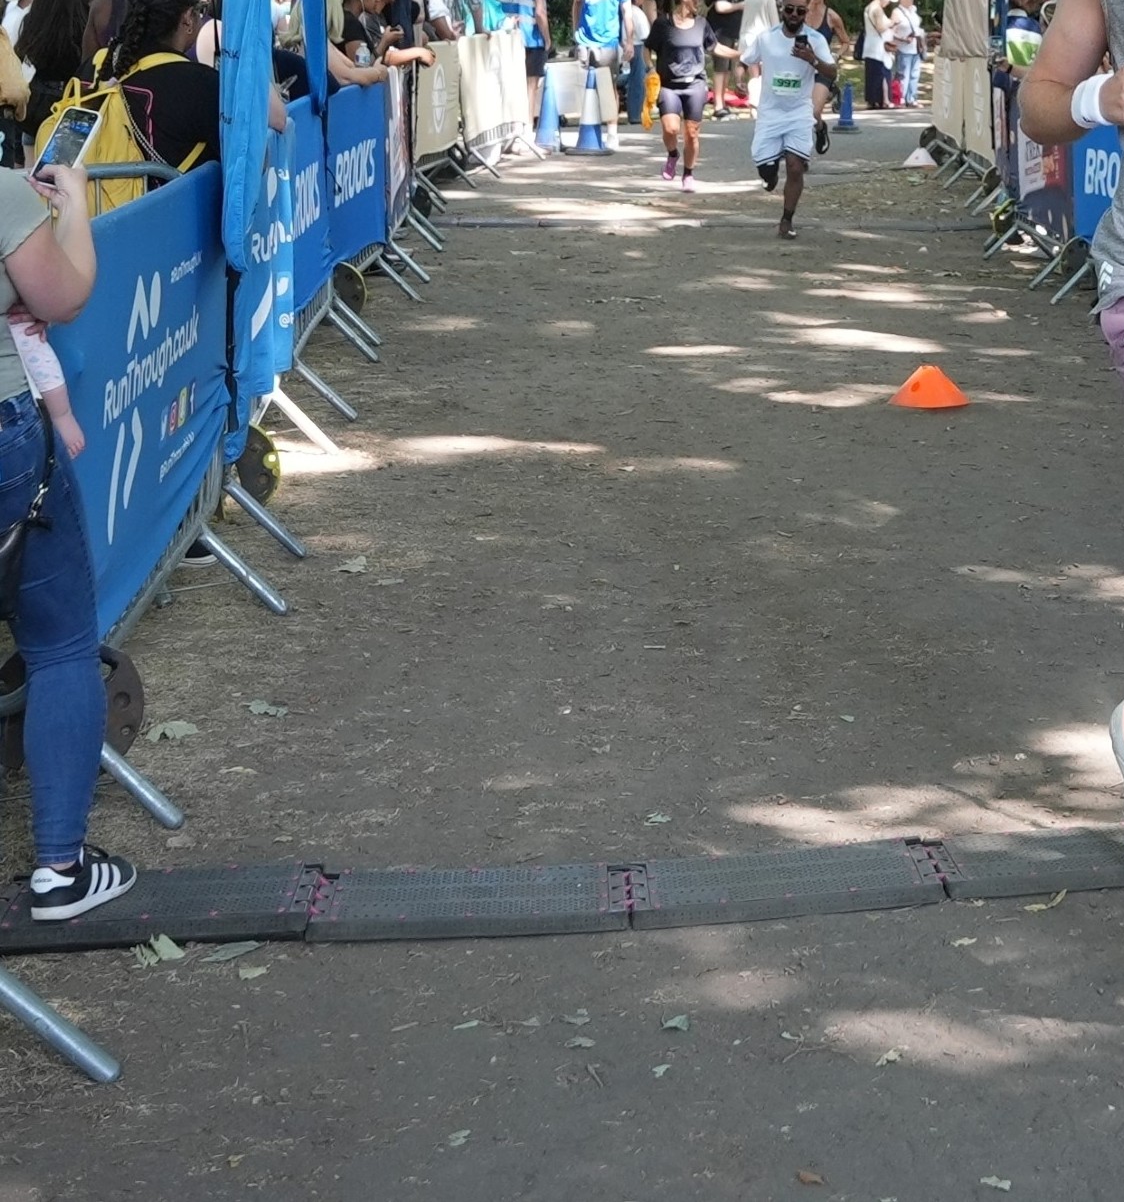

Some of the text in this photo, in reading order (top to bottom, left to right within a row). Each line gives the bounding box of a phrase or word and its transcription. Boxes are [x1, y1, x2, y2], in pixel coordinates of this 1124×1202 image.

[292, 160, 320, 242] ROOKS
[335, 139, 377, 208] BROOKS
[102, 304, 200, 430] RunThrough.co.uk
